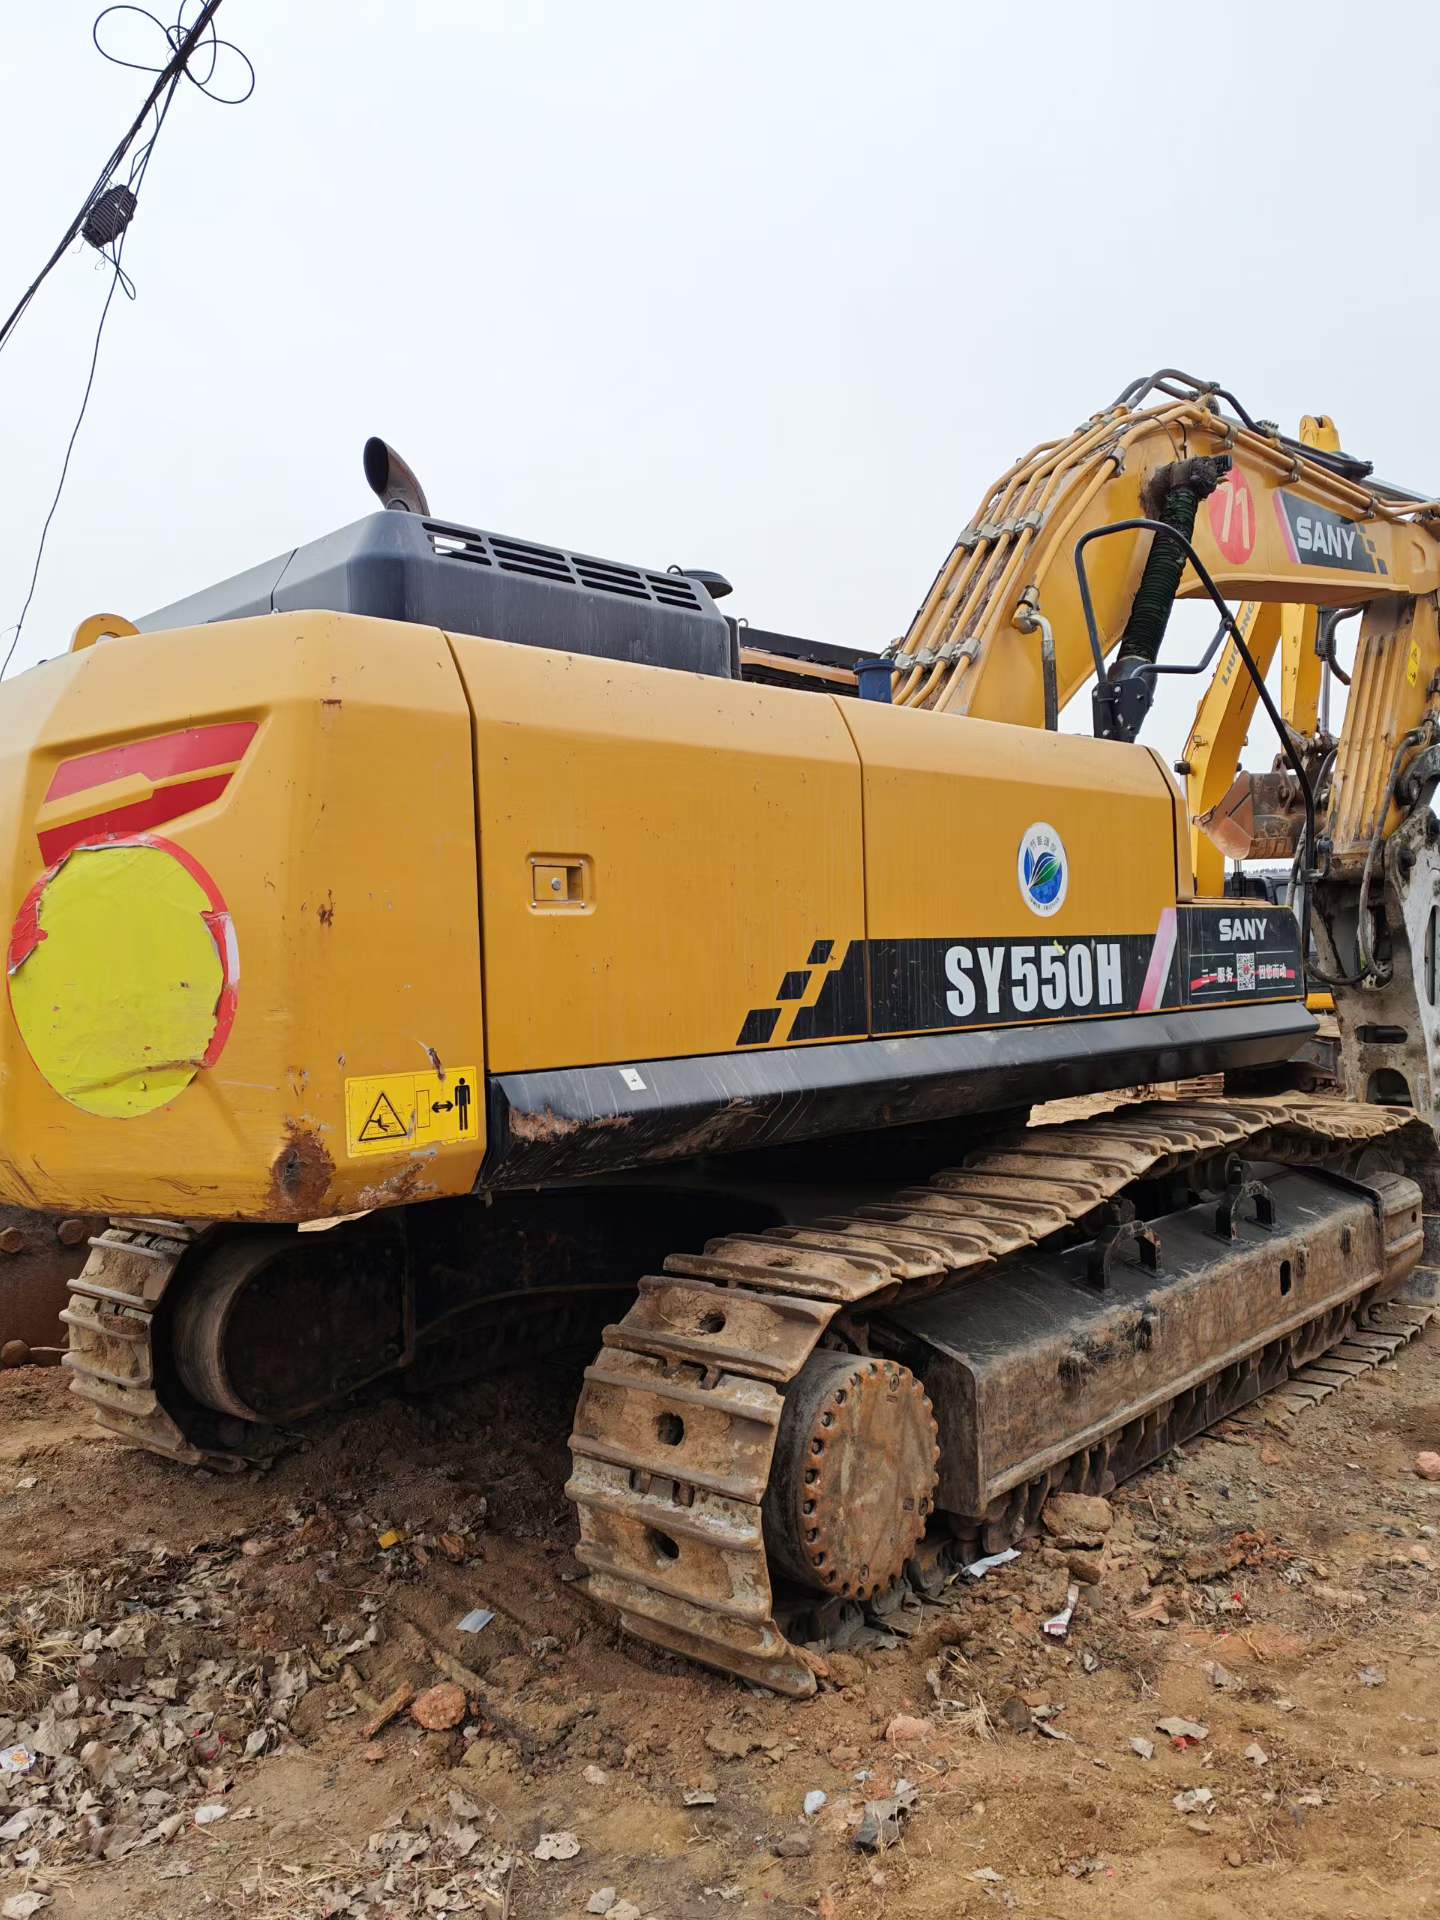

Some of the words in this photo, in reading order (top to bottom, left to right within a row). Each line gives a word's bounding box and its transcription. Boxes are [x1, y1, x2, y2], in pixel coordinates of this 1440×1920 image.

[1296, 516, 1357, 561] SANY
[1218, 918, 1268, 942] SANY
[944, 943, 1124, 1018] SY550H
